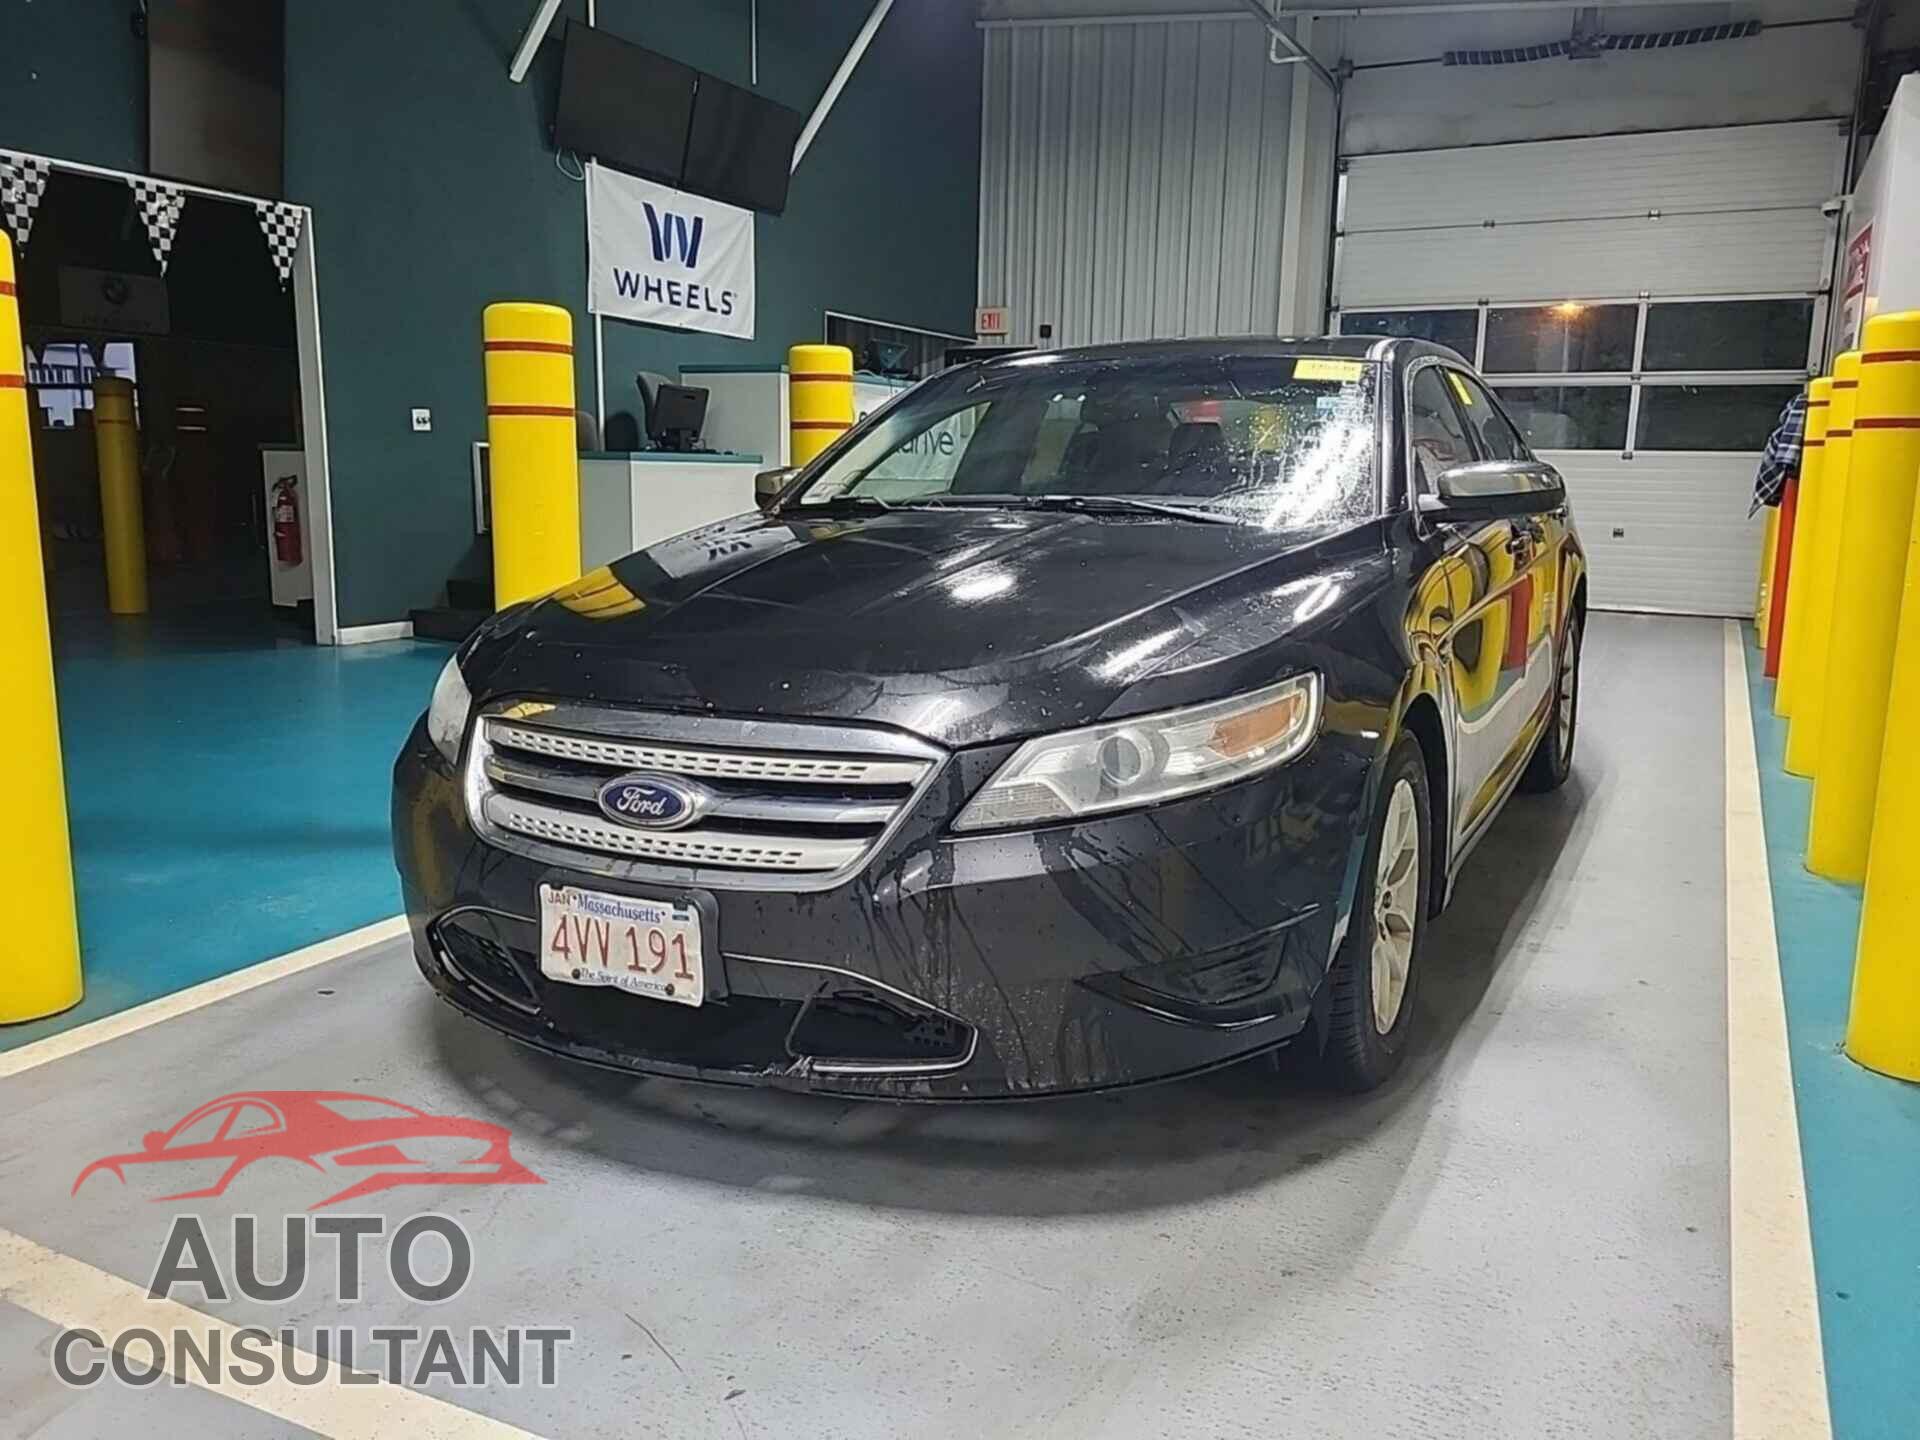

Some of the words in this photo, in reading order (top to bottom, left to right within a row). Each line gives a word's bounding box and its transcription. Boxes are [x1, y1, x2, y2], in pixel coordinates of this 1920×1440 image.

[613, 267, 738, 316] WHEELS
[981, 312, 1001, 330] EXIT
[616, 786, 668, 816] Ford
[549, 891, 571, 905] JAN
[577, 893, 661, 923] Massachusetts
[551, 914, 610, 968] 4VV
[625, 926, 695, 980] 191
[580, 967, 595, 979] The
